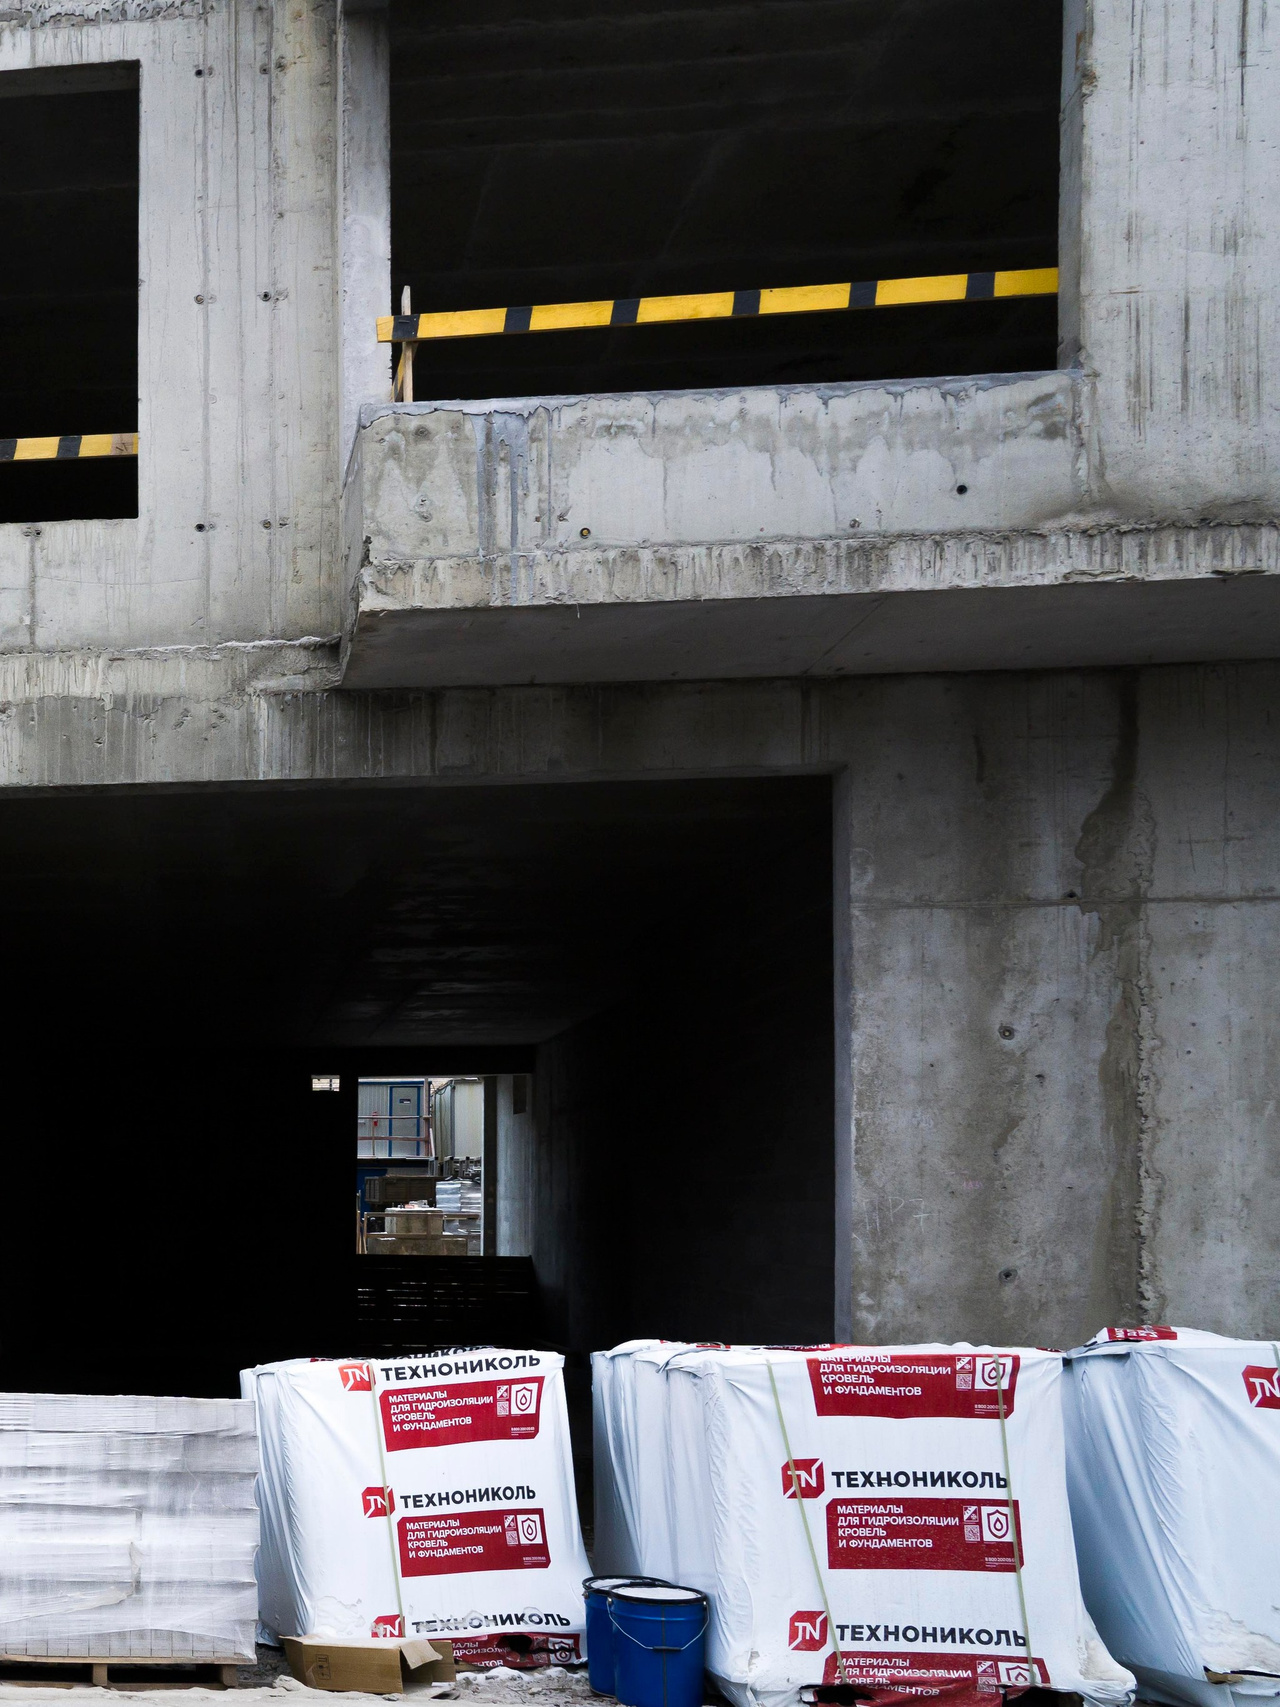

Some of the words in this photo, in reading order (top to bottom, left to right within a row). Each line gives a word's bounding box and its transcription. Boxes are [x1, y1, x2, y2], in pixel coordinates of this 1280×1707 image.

[380, 1354, 541, 1382] ТЕХНОНИКОЛЬ
[819, 1363, 844, 1373] ДЛЯ
[846, 1364, 951, 1375] ГИДРОИЗОЛЯЦИИ
[821, 1374, 875, 1384] КРОВЕЛЬ
[823, 1386, 833, 1395] И
[834, 1385, 922, 1396] ФУНДАМЕНТОВ
[388, 1390, 448, 1404] МАТЕРИАЛЫ
[390, 1403, 411, 1414] ДЛЯ
[412, 1396, 494, 1412] ГИДРОИЗОЛЯЦИИ
[391, 1412, 436, 1423] КРОВЕЛЬ
[393, 1424, 401, 1432] И
[402, 1416, 472, 1432] ФУНДАМЕНТОВ
[831, 1470, 1008, 1489] ТЕХНОНИКОЛЬ
[399, 1485, 537, 1509] ТЕХНОНИКОЛЬ
[836, 1504, 904, 1514] МАТЕРИАЛЫ
[405, 1518, 460, 1530] МАТЕРИАЛЫ
[837, 1516, 860, 1527] ДЛЯ
[861, 1516, 960, 1527] ГИДРОИЗОЛЯЦИИ
[406, 1531, 426, 1540] ДЛЯ
[427, 1525, 502, 1539] ГИДРОИЗОЛЯЦИИ
[838, 1528, 887, 1537] КРОВЕЛЬ
[407, 1539, 448, 1549] КРОВЕЛЬ
[838, 1539, 847, 1548] И
[848, 1538, 933, 1549] ФУНДАМЕНТОВ
[408, 1550, 416, 1559] И
[417, 1545, 484, 1558] ФУНДАМЕНТОВ
[788, 1612, 827, 1649] TN
[835, 1624, 1027, 1647] ТЕХНОНИКОЛЬ
[862, 1667, 972, 1678] ГИДРОИЗОЛЯЦИИ
